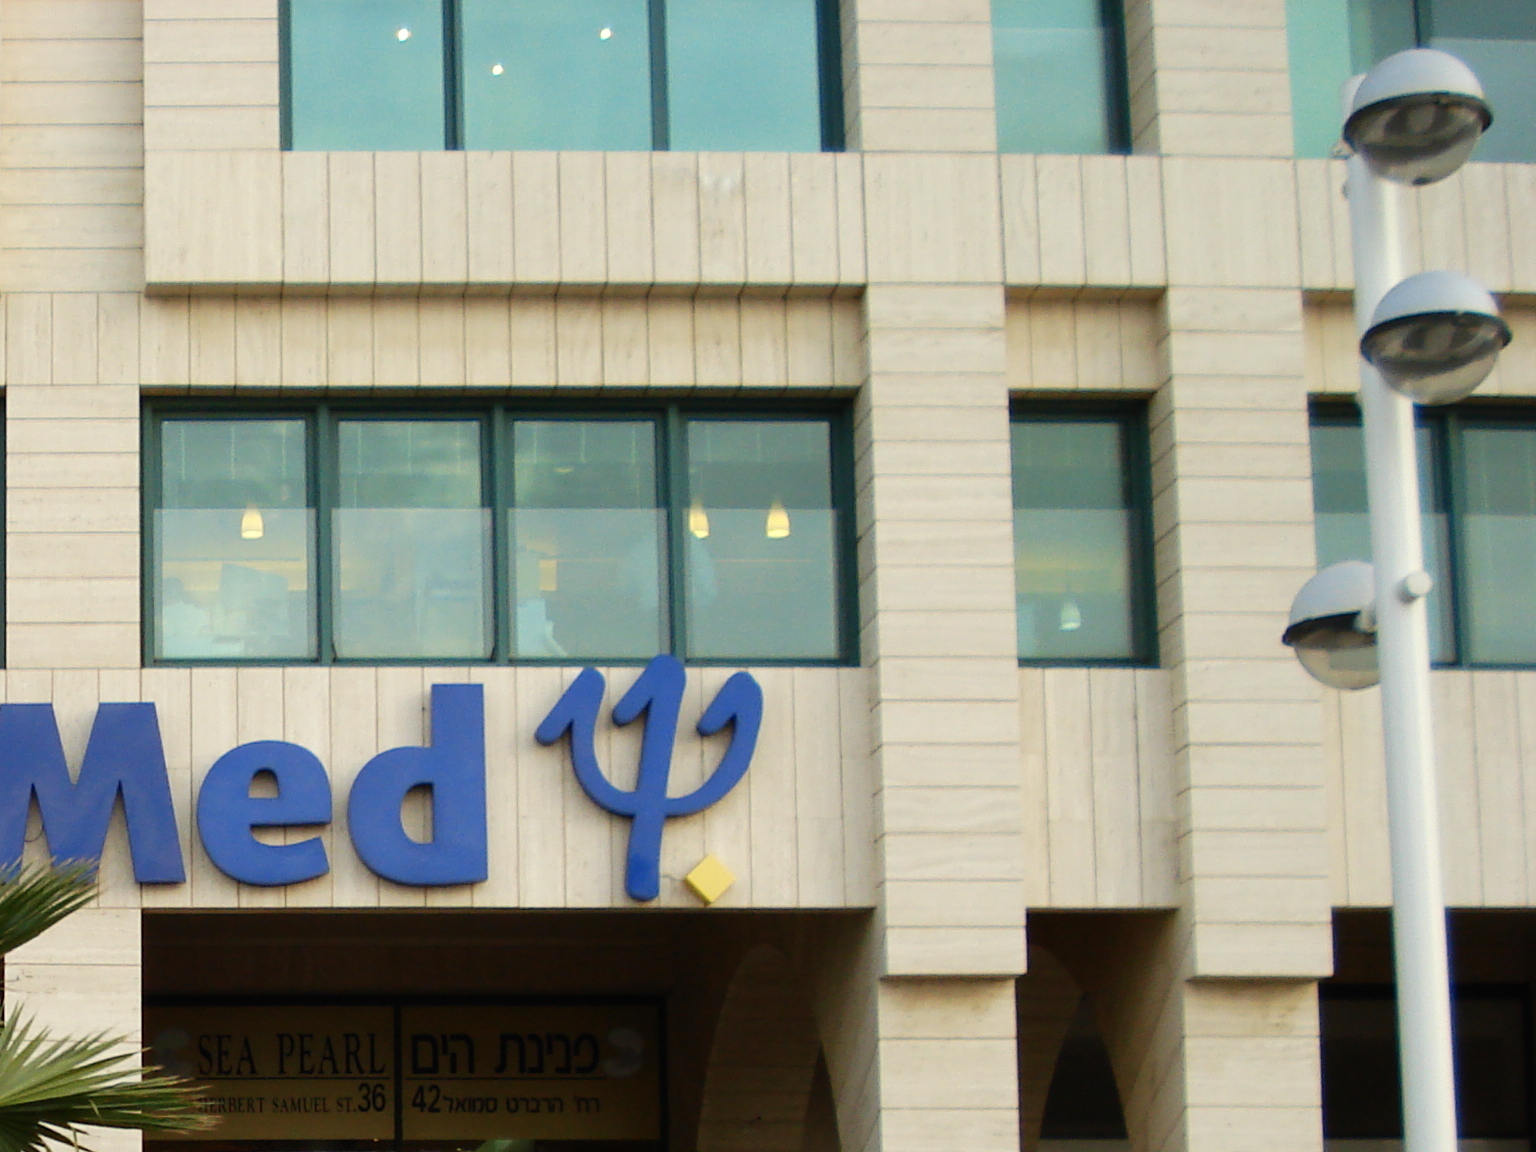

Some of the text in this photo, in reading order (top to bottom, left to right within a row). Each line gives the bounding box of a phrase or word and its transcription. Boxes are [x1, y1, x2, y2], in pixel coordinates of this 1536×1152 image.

[197, 1032, 386, 1076] SEA PEARL
[411, 1032, 600, 1075] פנינת הים
[271, 1097, 330, 1114] SAMUEL
[358, 1082, 386, 1113] 36
[411, 1084, 441, 1113] 42
[505, 1096, 564, 1114] הרברט
